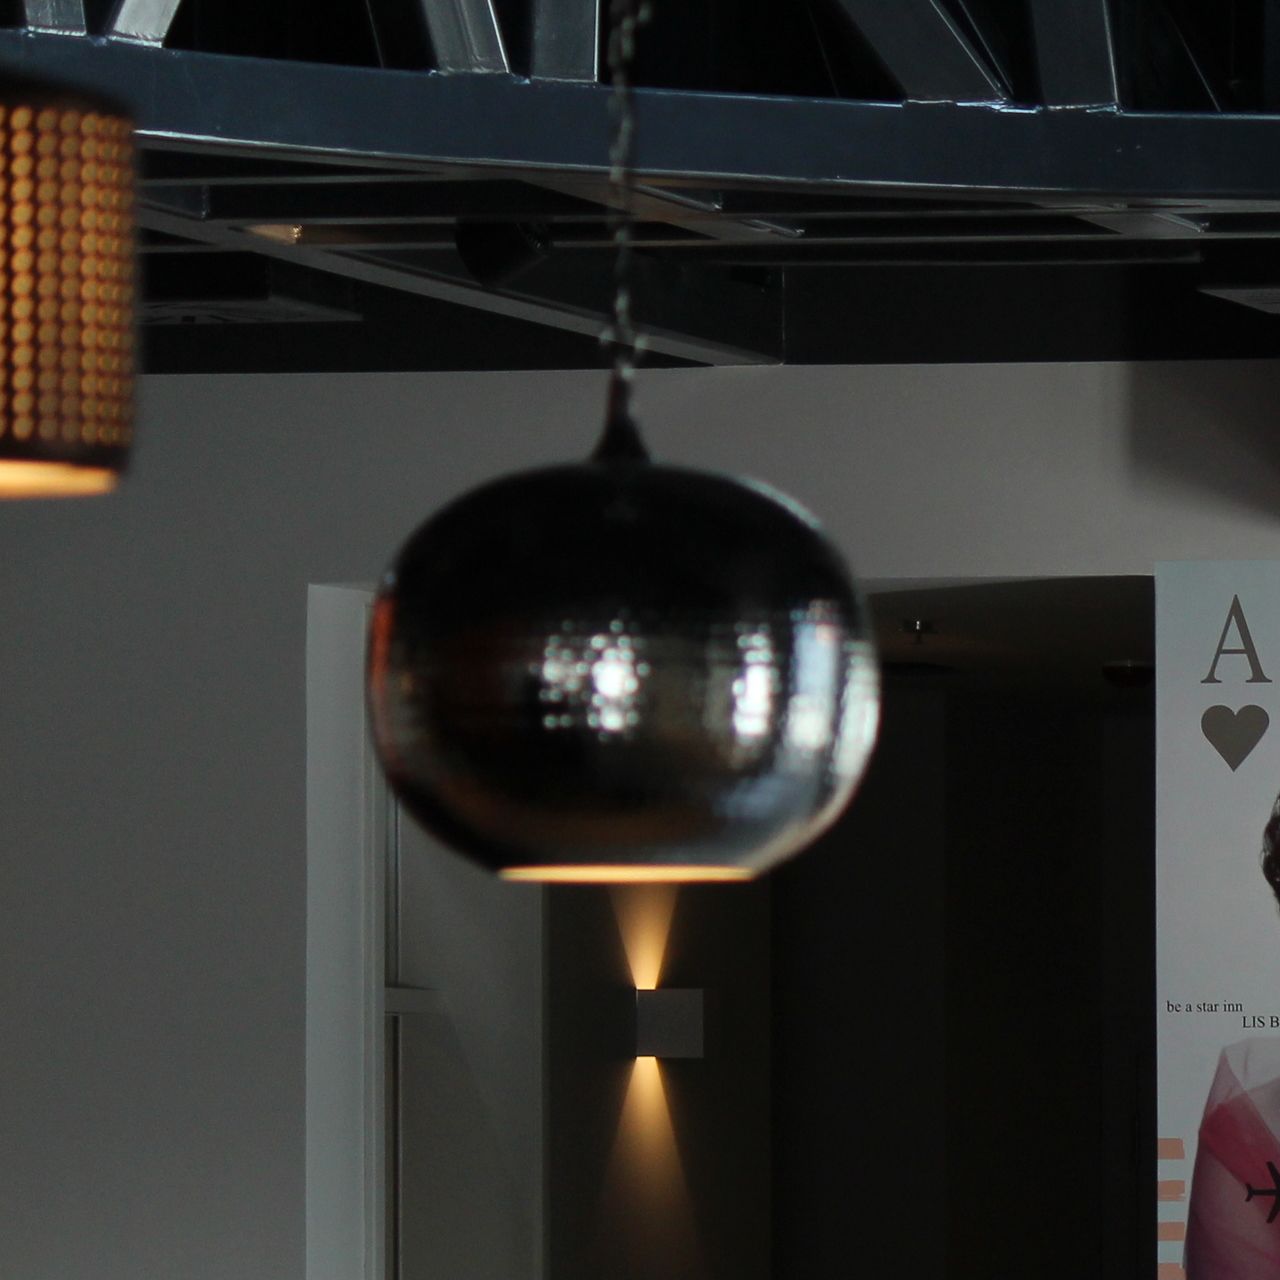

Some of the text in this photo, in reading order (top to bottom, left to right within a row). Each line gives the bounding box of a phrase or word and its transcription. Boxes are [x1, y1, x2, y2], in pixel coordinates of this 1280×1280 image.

[1200, 594, 1272, 684] A
[1166, 1000, 1243, 1013] be a star inn
[1242, 1015, 1266, 1029] LIS
[1270, 1015, 1280, 1028] B
